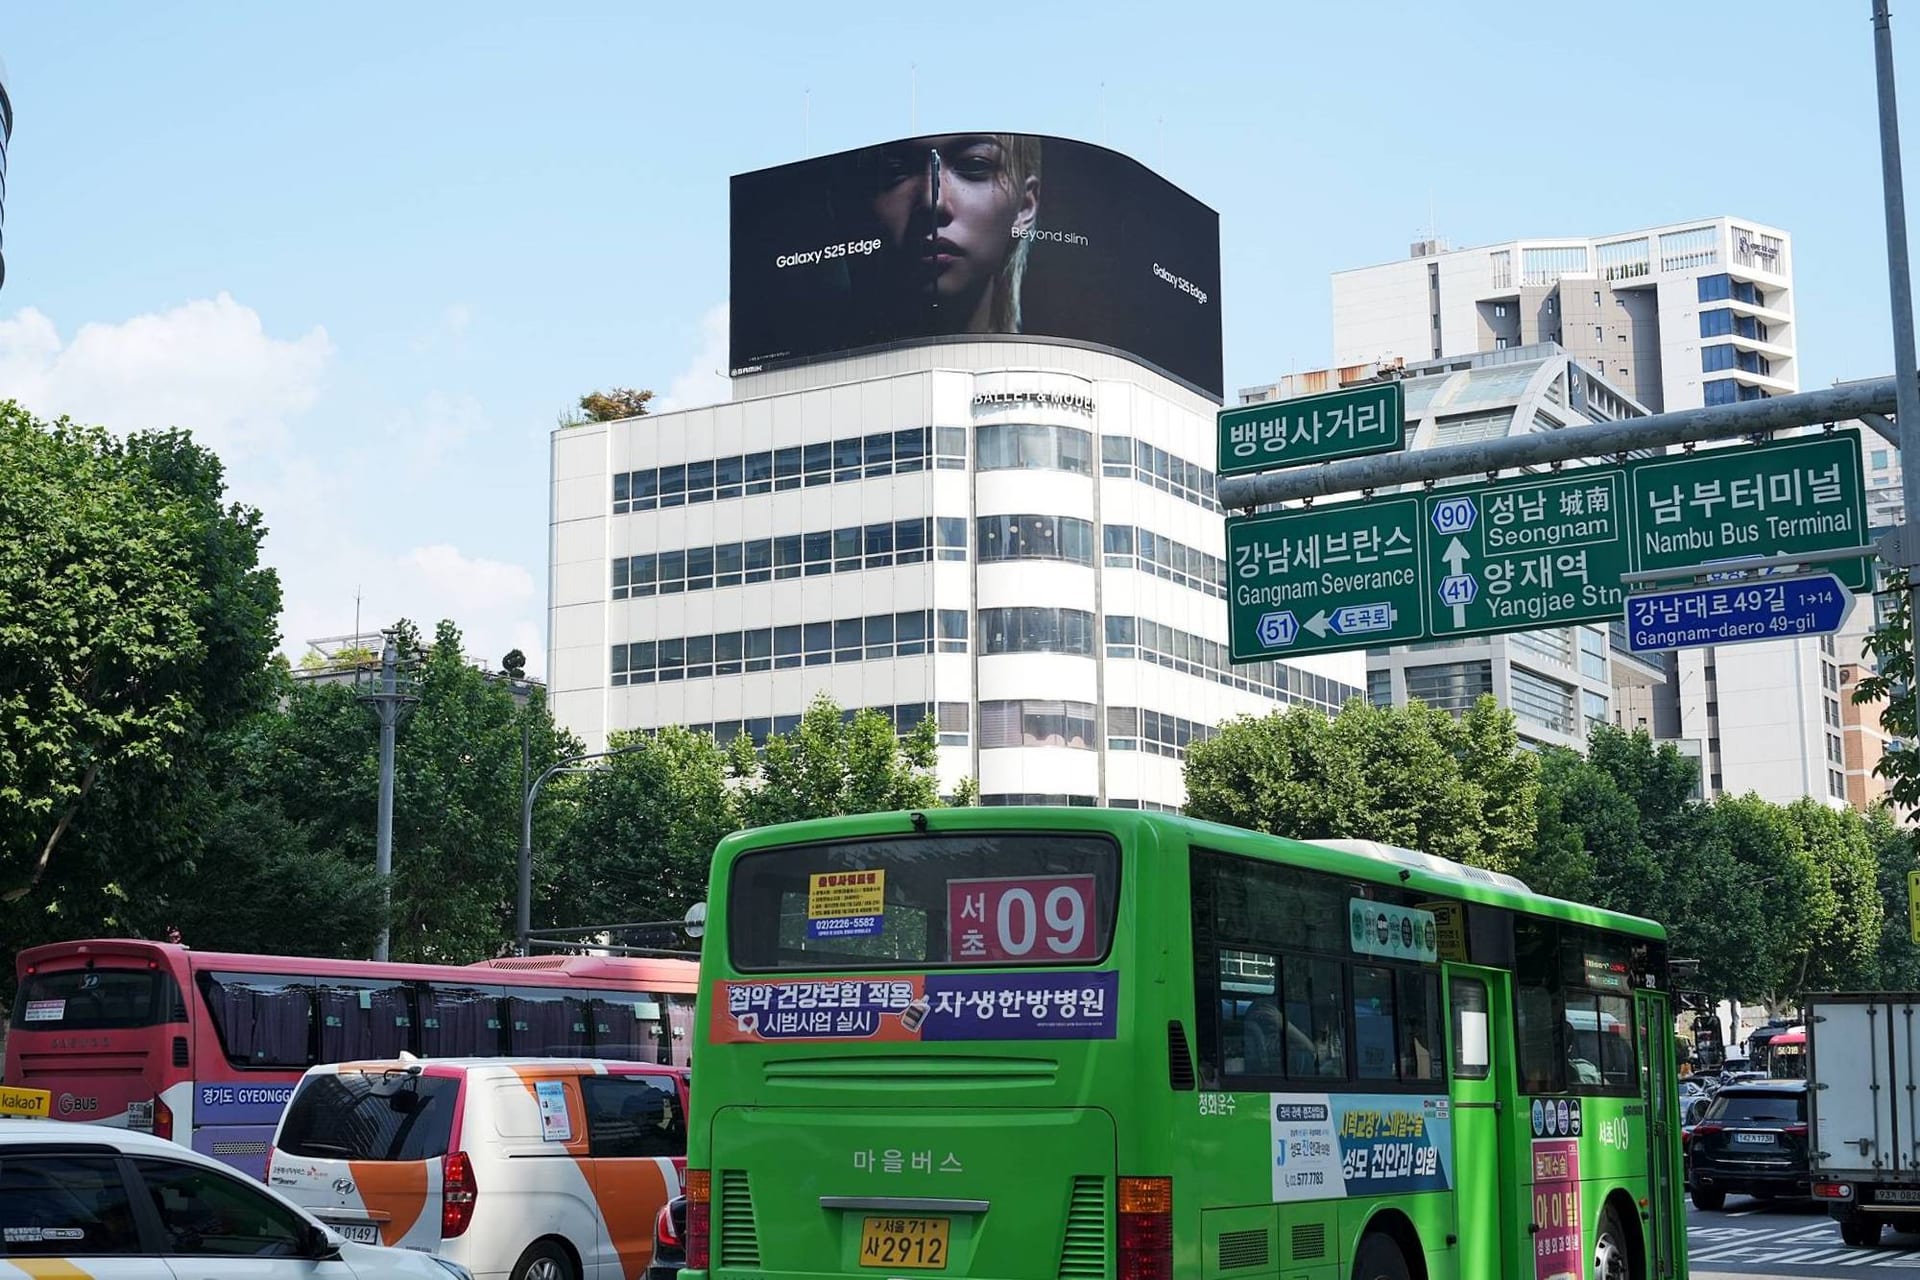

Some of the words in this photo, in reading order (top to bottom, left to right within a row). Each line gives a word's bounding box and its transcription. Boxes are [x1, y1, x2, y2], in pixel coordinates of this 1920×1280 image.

[1011, 226, 1062, 242] Beyond
[1064, 232, 1089, 247] slim
[776, 249, 822, 268] Galaxy
[824, 243, 846, 259] S25
[847, 238, 882, 255] Edge
[1153, 262, 1178, 289] Galaxy
[1177, 276, 1190, 293] S25
[1189, 283, 1208, 304] Edge
[974, 392, 1032, 405] BALLET
[1231, 400, 1386, 456] 뱅뱅사거리
[1489, 490, 1547, 525] 성남
[1560, 486, 1609, 516] 城南
[1649, 463, 1842, 525] 남부터미널
[1441, 504, 1468, 527] 90
[1646, 527, 1714, 555] Nambu
[1721, 521, 1760, 546] Bus
[1766, 507, 1852, 539] Terminal
[1489, 518, 1608, 547] Seongnam
[1236, 526, 1412, 578] 강남세브란스
[1237, 580, 1318, 607] Gangnam
[1321, 568, 1415, 594] Severance
[1484, 550, 1588, 595] 양재역
[1447, 579, 1470, 600] 41
[1486, 592, 1575, 618] Yangjae
[1582, 584, 1622, 606] Stn
[1343, 609, 1386, 628] 도곡로
[1635, 586, 1786, 626] 강남대로49길
[1266, 618, 1290, 640] 51
[1636, 622, 1765, 647] Gangnam-daero
[1769, 613, 1816, 633] 49-gil
[960, 893, 986, 956] 서초
[997, 886, 1085, 956] 09
[730, 984, 772, 1011] 첩약
[777, 982, 862, 1009] 건강보험
[867, 982, 912, 1008] 적용
[935, 988, 1105, 1020] 자생한방병원
[764, 1012, 835, 1033] 시범사업
[836, 1011, 871, 1032] 실시
[203, 1088, 233, 1105] 경기도
[1339, 1111, 1380, 1138] 시력교정?
[1382, 1112, 1424, 1138] 스마일수술
[854, 1149, 963, 1174] 마을버스
[1343, 1148, 1368, 1180] 성모
[1371, 1143, 1414, 1179] 진안과
[1414, 1146, 1437, 1176] 의원
[344, 1226, 371, 1241] 0149
[884, 1220, 905, 1233] 서울
[908, 1220, 927, 1234] 71
